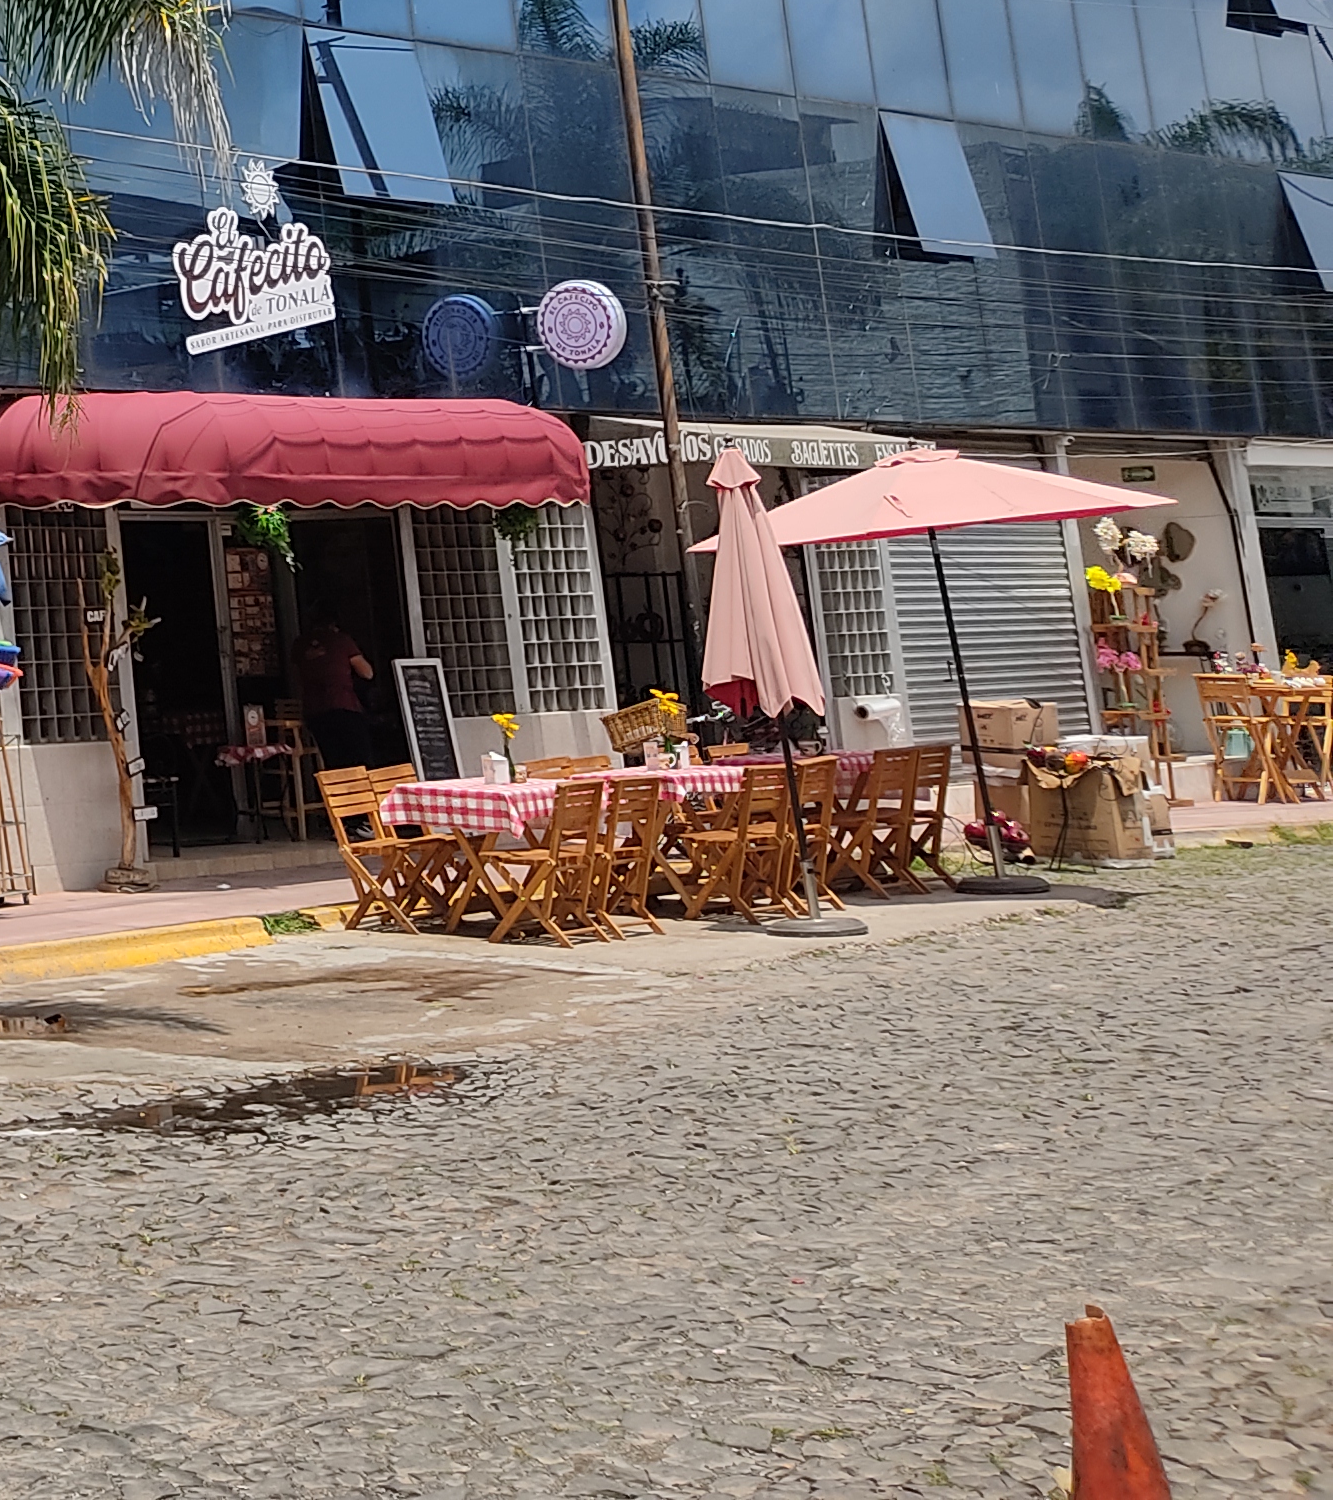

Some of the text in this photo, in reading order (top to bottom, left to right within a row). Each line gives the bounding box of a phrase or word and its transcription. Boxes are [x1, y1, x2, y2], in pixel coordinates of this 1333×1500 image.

[212, 211, 235, 250] El
[178, 228, 326, 321] Cafecito
[251, 302, 263, 317] de
[557, 294, 598, 311] CAFECITO
[190, 307, 333, 350] SABOR ARTESANAL PARA DISFRUTAR
[86, 609, 107, 623] CAF
